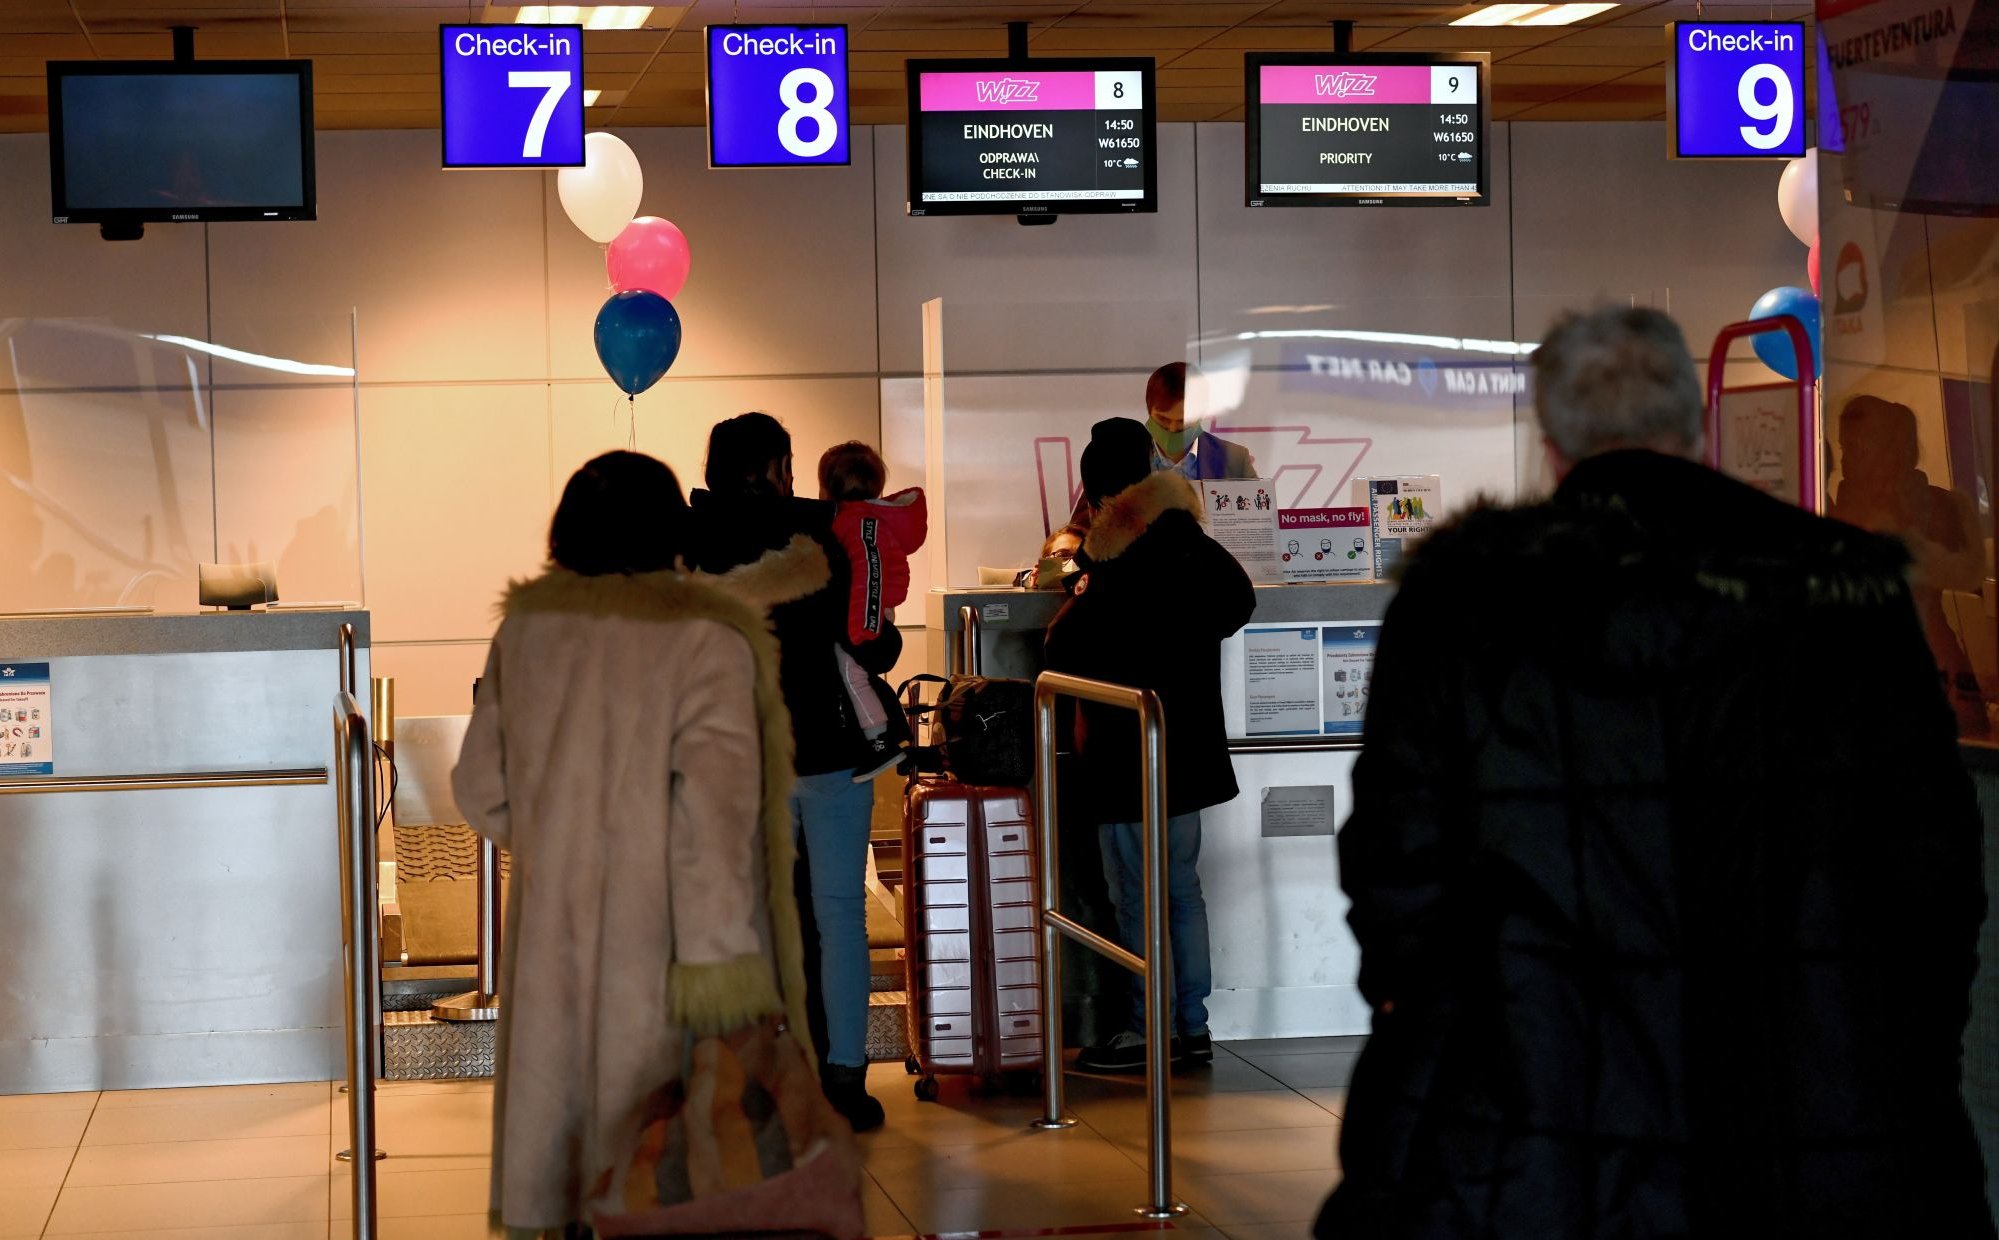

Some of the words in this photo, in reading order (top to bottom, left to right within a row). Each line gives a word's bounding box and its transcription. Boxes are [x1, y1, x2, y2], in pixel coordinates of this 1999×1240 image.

[455, 32, 571, 57] Check-in
[723, 32, 836, 56] Check-in
[1688, 29, 1794, 52] Check-in
[1113, 82, 1124, 99] 8
[1448, 77, 1459, 93] 9
[777, 67, 838, 157] 8
[1737, 63, 1794, 150] 9
[507, 71, 572, 158] 7
[1439, 114, 1468, 125] 14:50
[963, 123, 1054, 140] EINDHOVEN
[1104, 119, 1134, 131] 14:50
[1302, 117, 1390, 132] EINDHOVEN
[1098, 137, 1140, 148] W61650
[1433, 132, 1474, 143] W61650
[1103, 159, 1122, 168] 10°C
[1319, 153, 1373, 164] PRIORITY
[1438, 153, 1456, 162] 10°C
[983, 168, 1036, 179] CHECK-IN
[1281, 514, 1297, 524] No
[1299, 512, 1330, 524] mask,
[1332, 513, 1346, 522] no
[1348, 511, 1365, 523] fly!
[865, 520, 874, 541] STYLE
